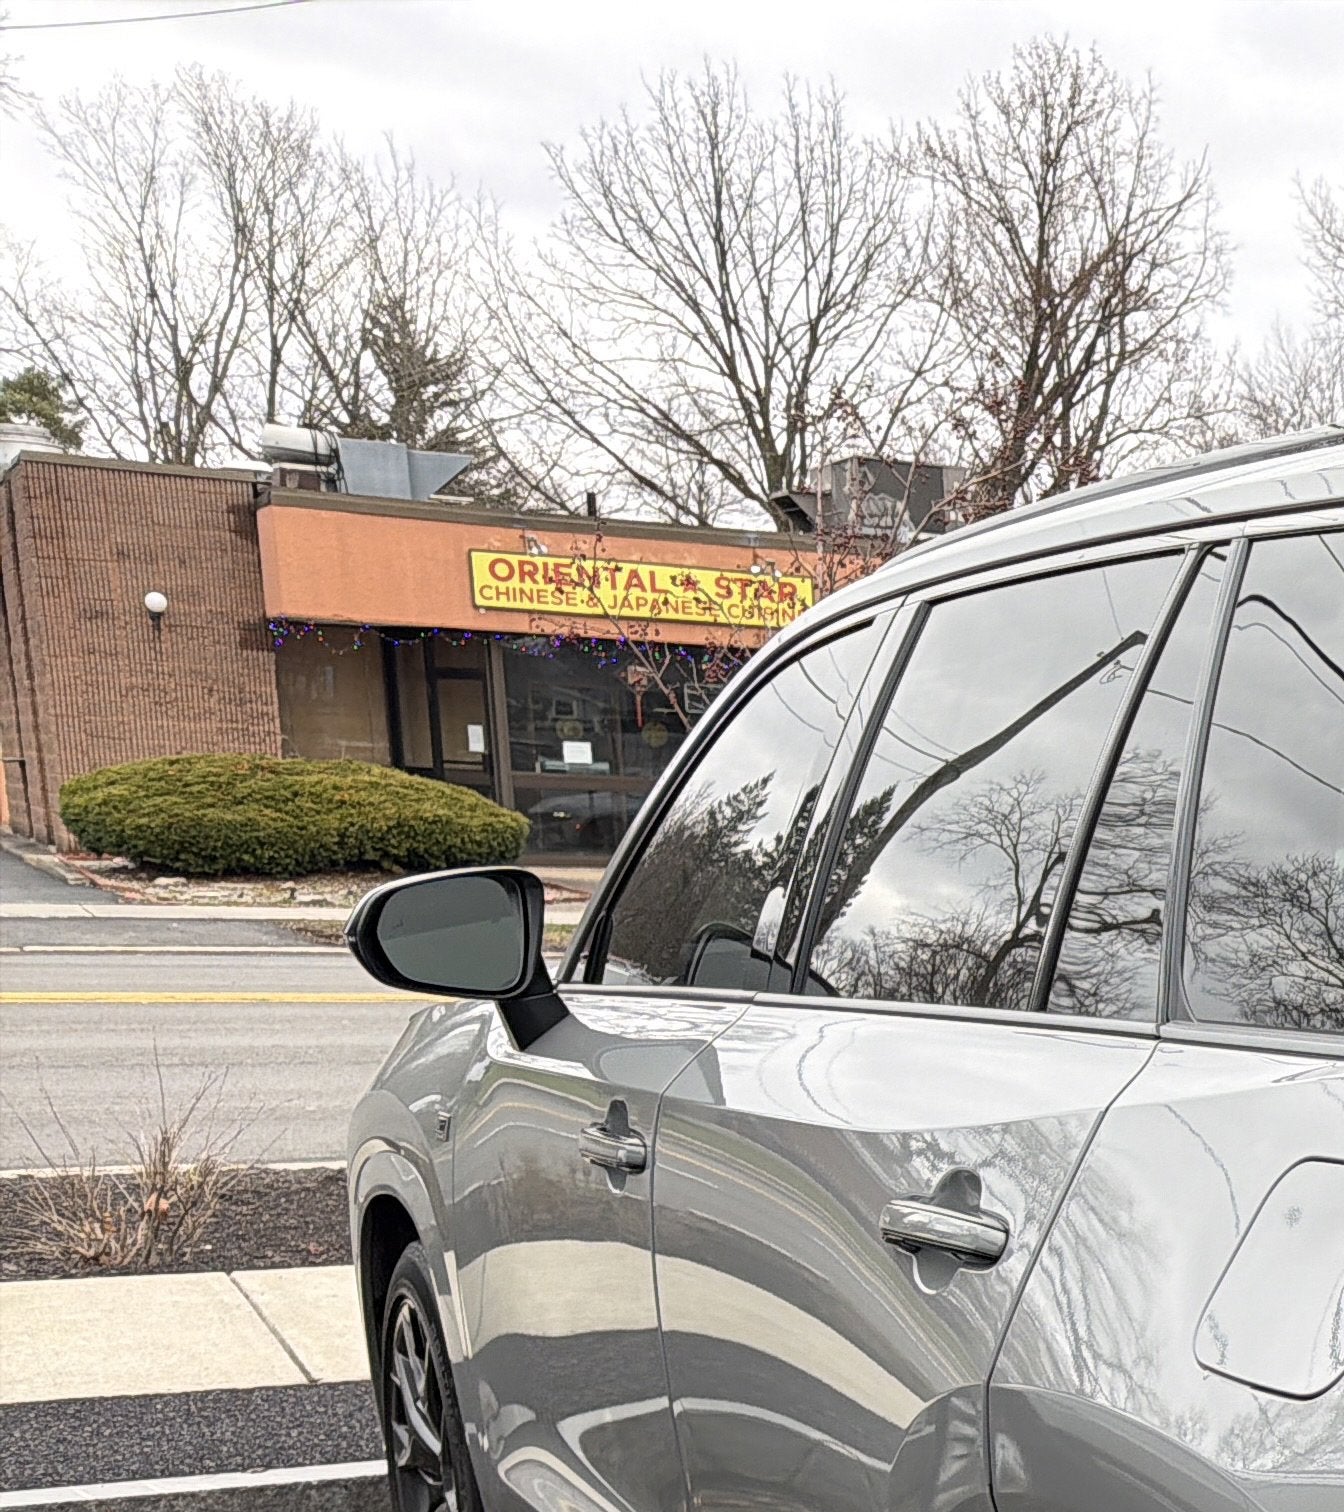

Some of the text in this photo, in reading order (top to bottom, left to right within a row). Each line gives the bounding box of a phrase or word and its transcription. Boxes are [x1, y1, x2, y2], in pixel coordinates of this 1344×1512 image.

[488, 557, 798, 604] ORIENTAL STAR
[478, 584, 805, 624] CHINESE & JAPANESE CUISIN
